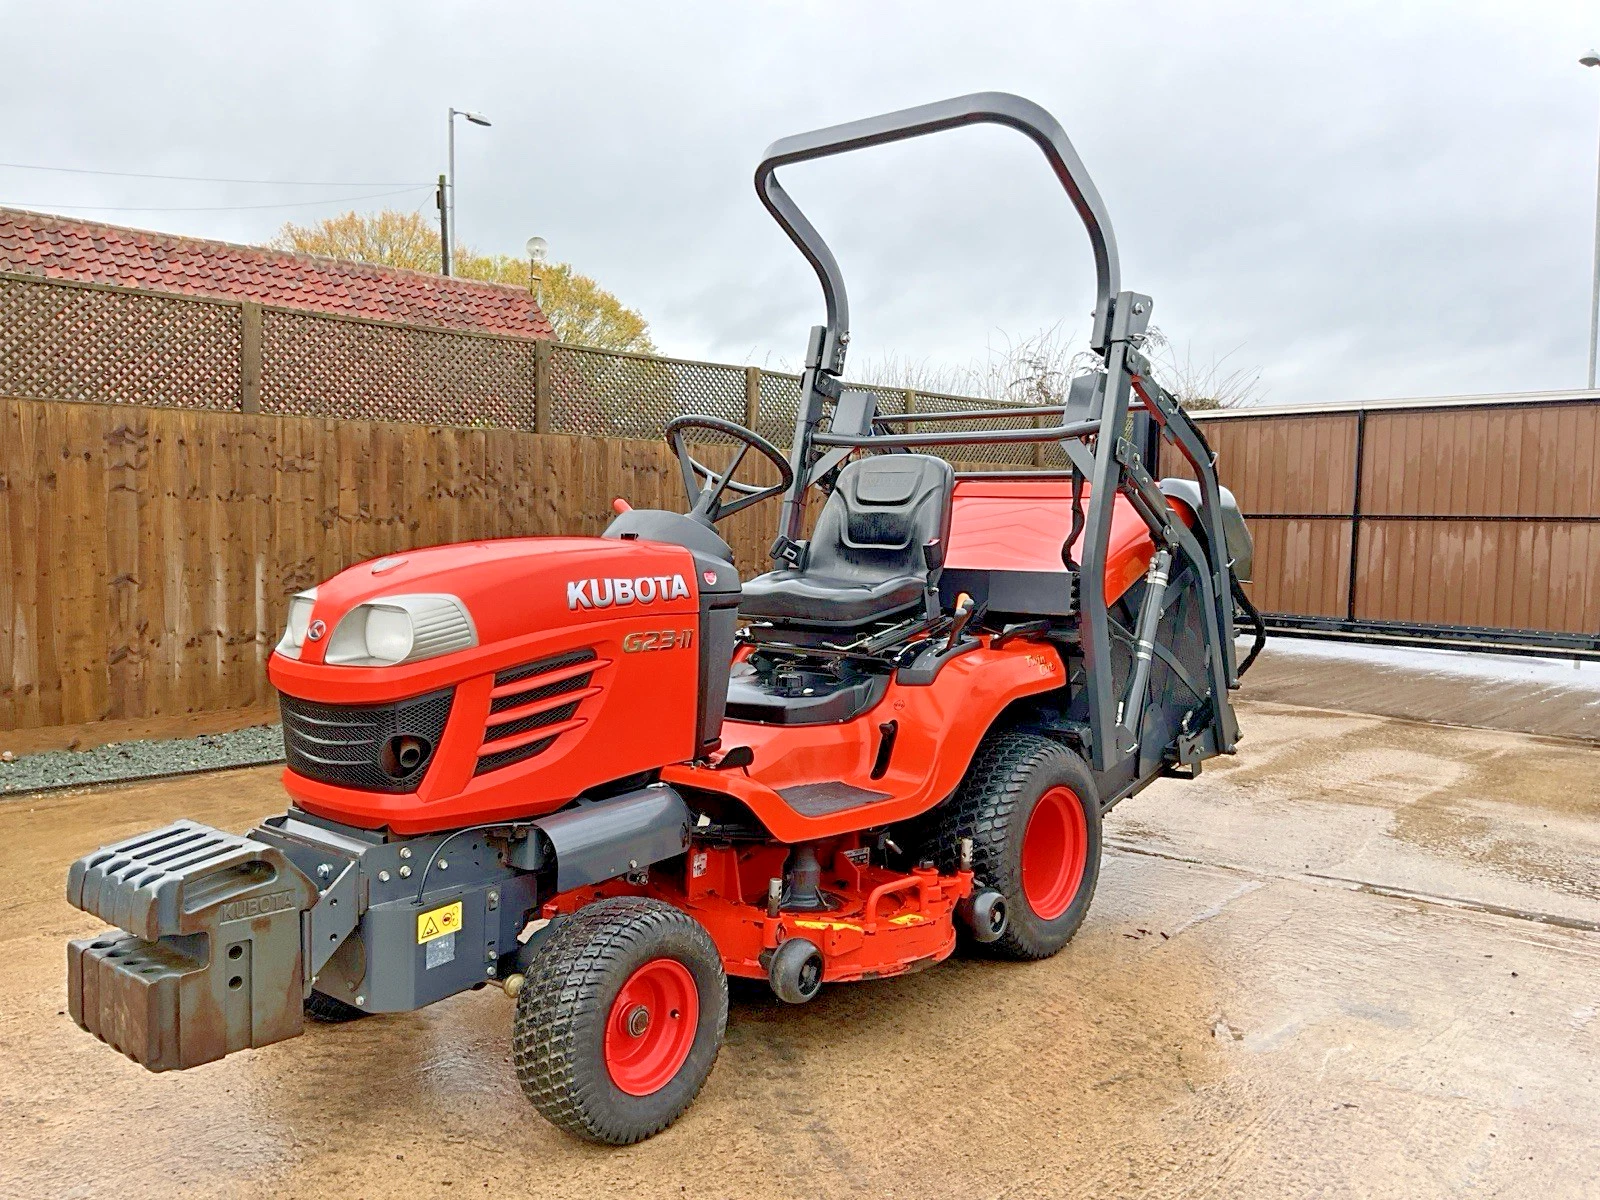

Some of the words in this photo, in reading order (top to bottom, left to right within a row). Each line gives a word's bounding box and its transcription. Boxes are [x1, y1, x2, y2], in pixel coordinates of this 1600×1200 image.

[567, 574, 690, 610] KUBOTA
[1025, 655, 1047, 668] Twin
[222, 892, 293, 921] KUBOTA
